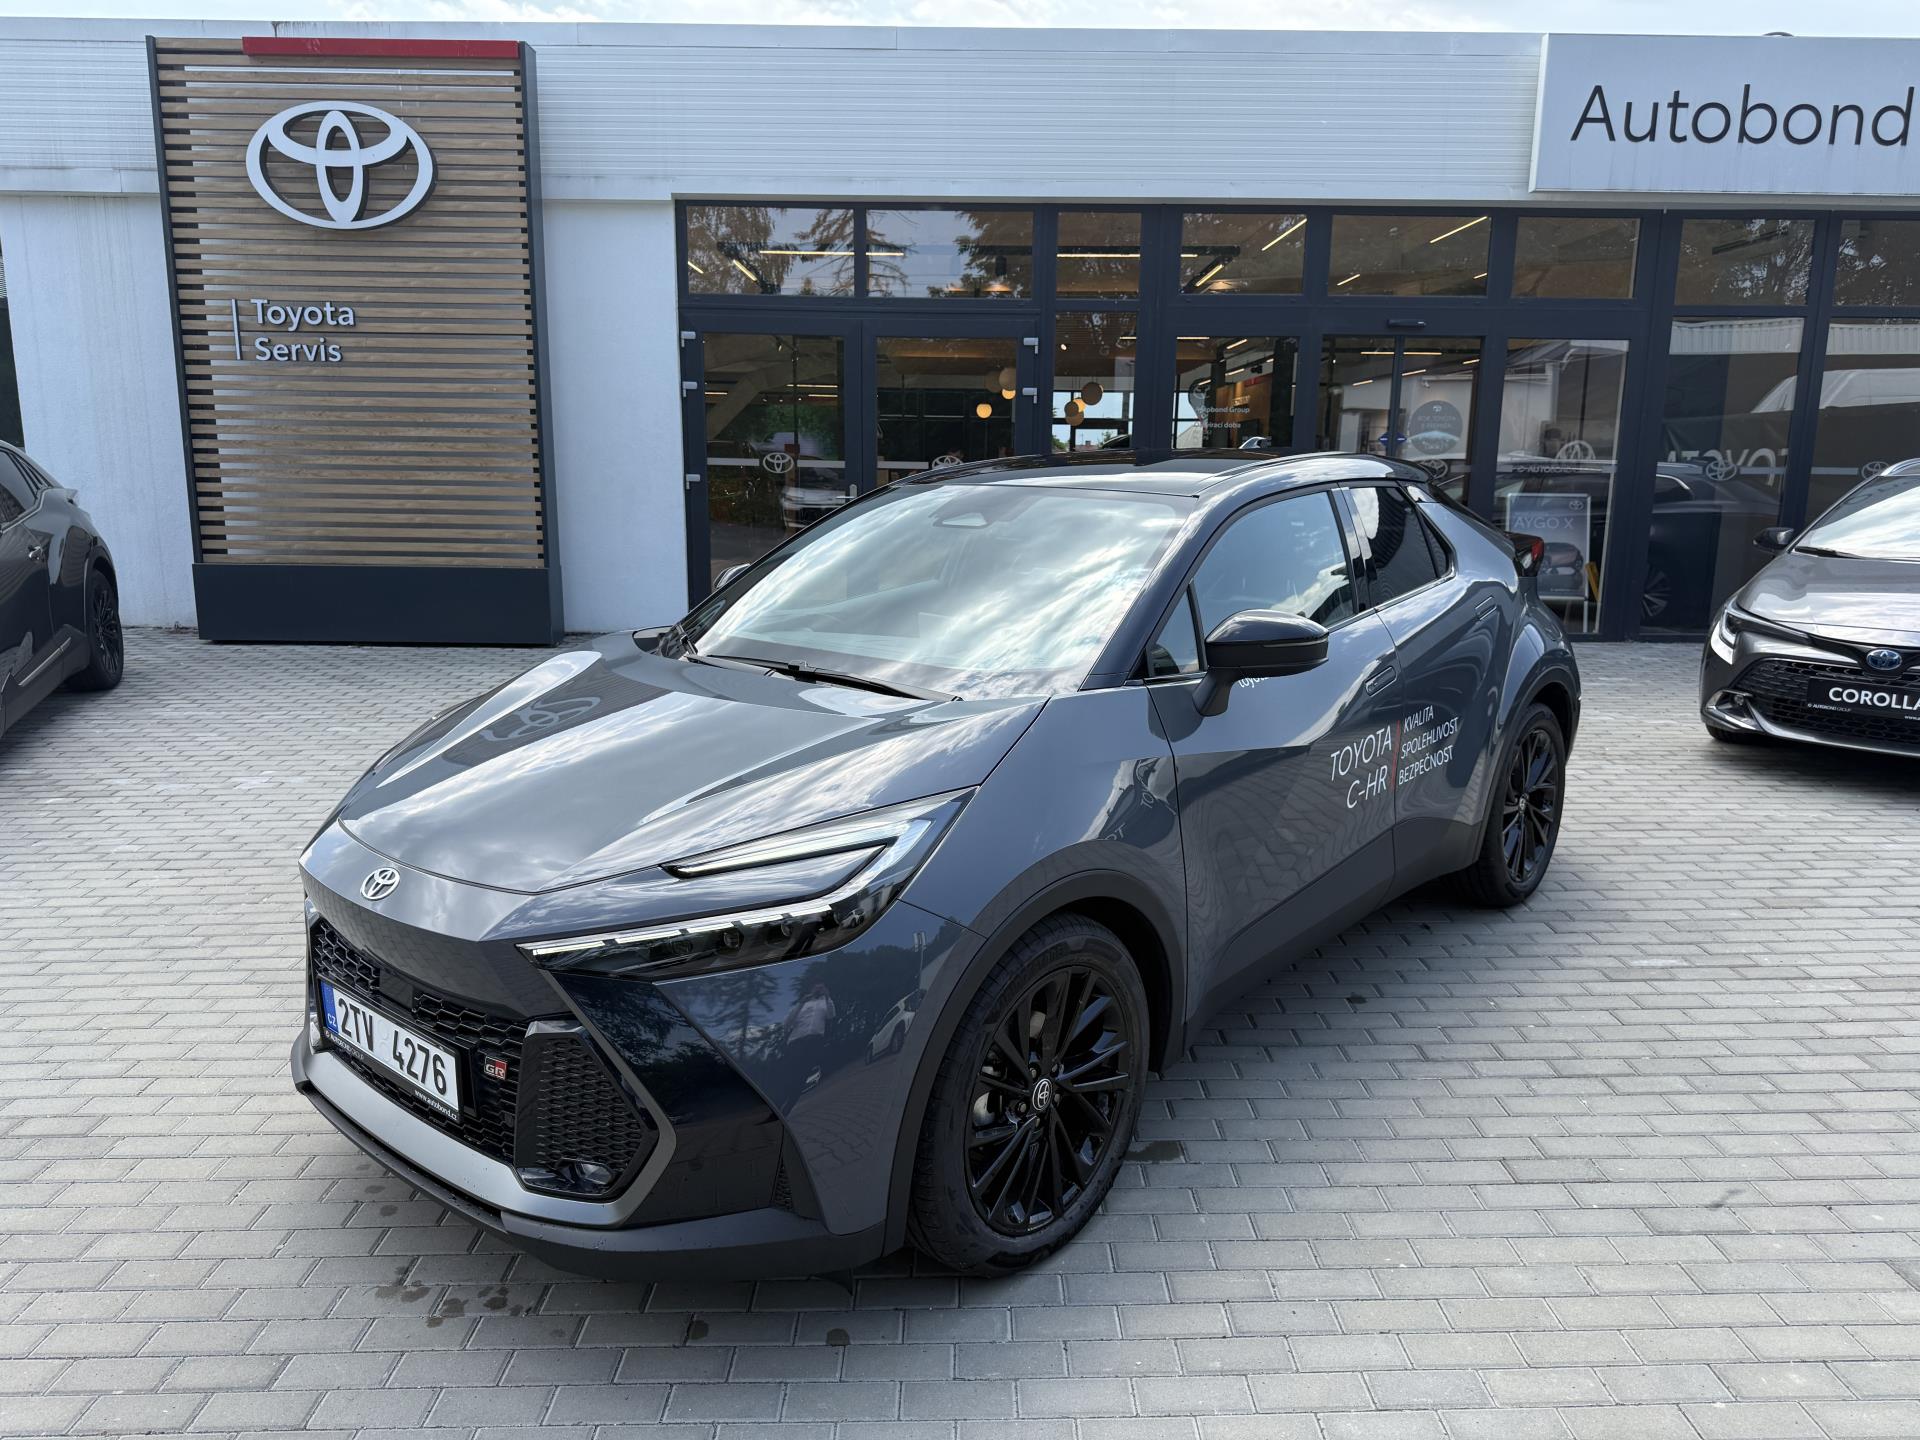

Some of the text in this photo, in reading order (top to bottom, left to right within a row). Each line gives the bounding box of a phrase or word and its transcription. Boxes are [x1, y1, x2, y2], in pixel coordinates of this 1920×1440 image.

[1570, 84, 1916, 147] Autobond
[250, 298, 355, 332] Toyota
[254, 337, 342, 362] Servis
[1514, 516, 1575, 529] AYGO X
[1403, 705, 1434, 733] KVALITA
[1330, 725, 1392, 781] TOYOTA
[1401, 717, 1459, 759] SPOLEHLIVOST
[1399, 745, 1454, 785] BEZPEČNOST
[1346, 765, 1388, 808] C-HR
[327, 1013, 337, 1027] CZ
[338, 997, 448, 1096] 2TV 4276
[485, 1063, 506, 1078] GR
